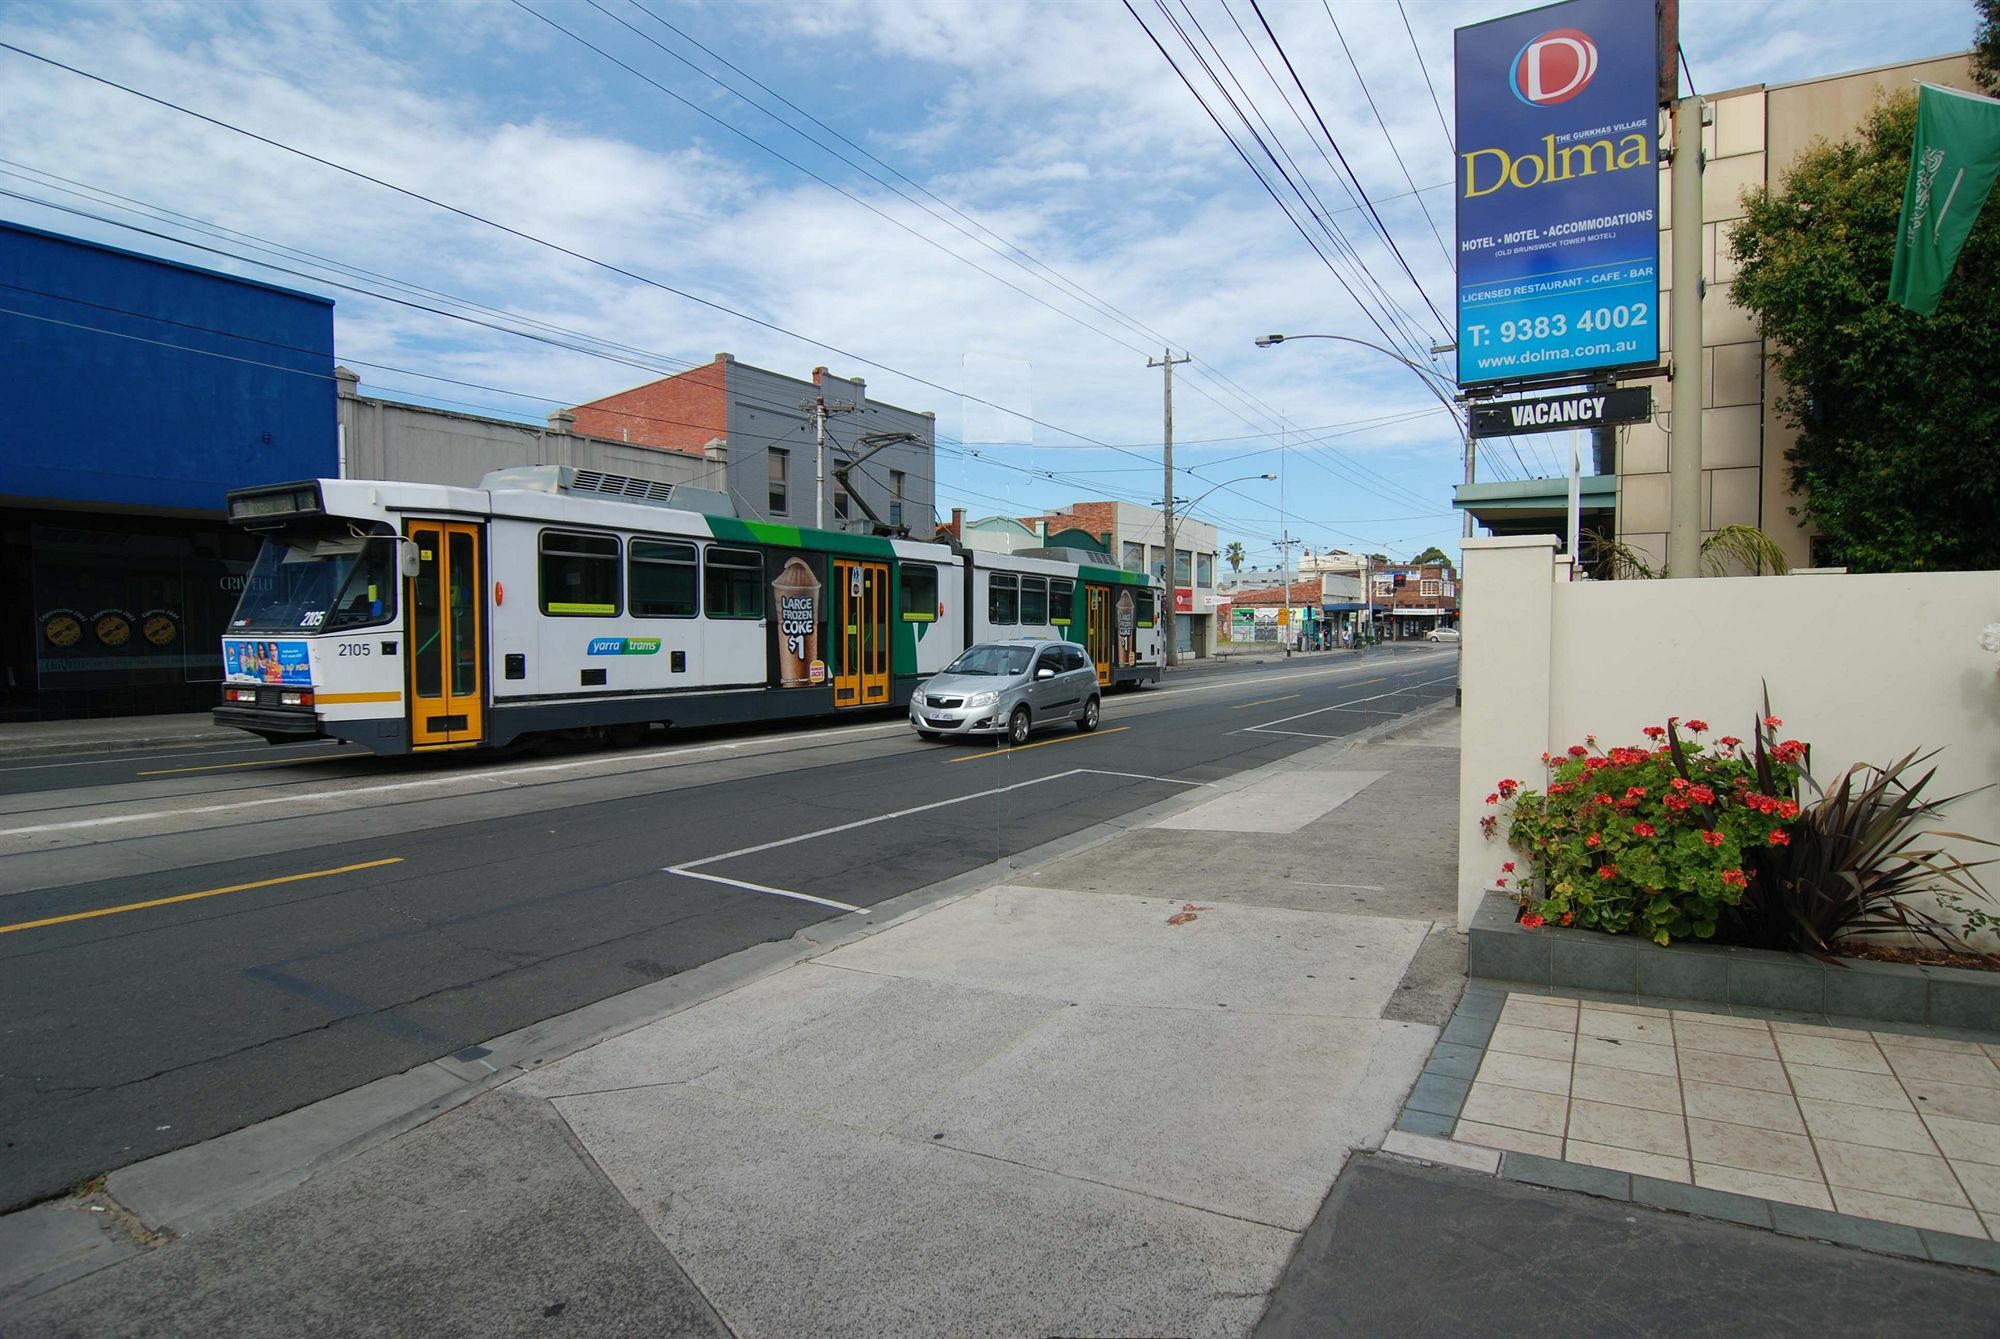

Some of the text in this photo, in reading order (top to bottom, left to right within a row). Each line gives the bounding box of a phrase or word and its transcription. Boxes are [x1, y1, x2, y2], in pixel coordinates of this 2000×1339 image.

[1555, 119, 1647, 143] THE GURKHAS VILLAGE
[1461, 133, 1650, 198] Dolma
[1462, 235, 1495, 251] HOTEL
[1504, 229, 1539, 244] MOTEL
[1495, 231, 1616, 258] (OLD BRUNSWICK TOWER MOTEL)
[1462, 267, 1653, 303] LICENSED RESTAURANT CAFE BAR
[1467, 302, 1648, 347] T: 9383 4002
[1478, 339, 1637, 369] www.dolma.com.au
[1511, 397, 1606, 427] VACANCY
[782, 597, 813, 610] LARGE
[782, 610, 812, 620] FROZEN
[300, 611, 326, 626] 2105
[782, 620, 813, 634] COKE
[338, 643, 371, 657] 2105
[593, 640, 656, 653] yarra trams
[788, 635, 804, 660] $1
